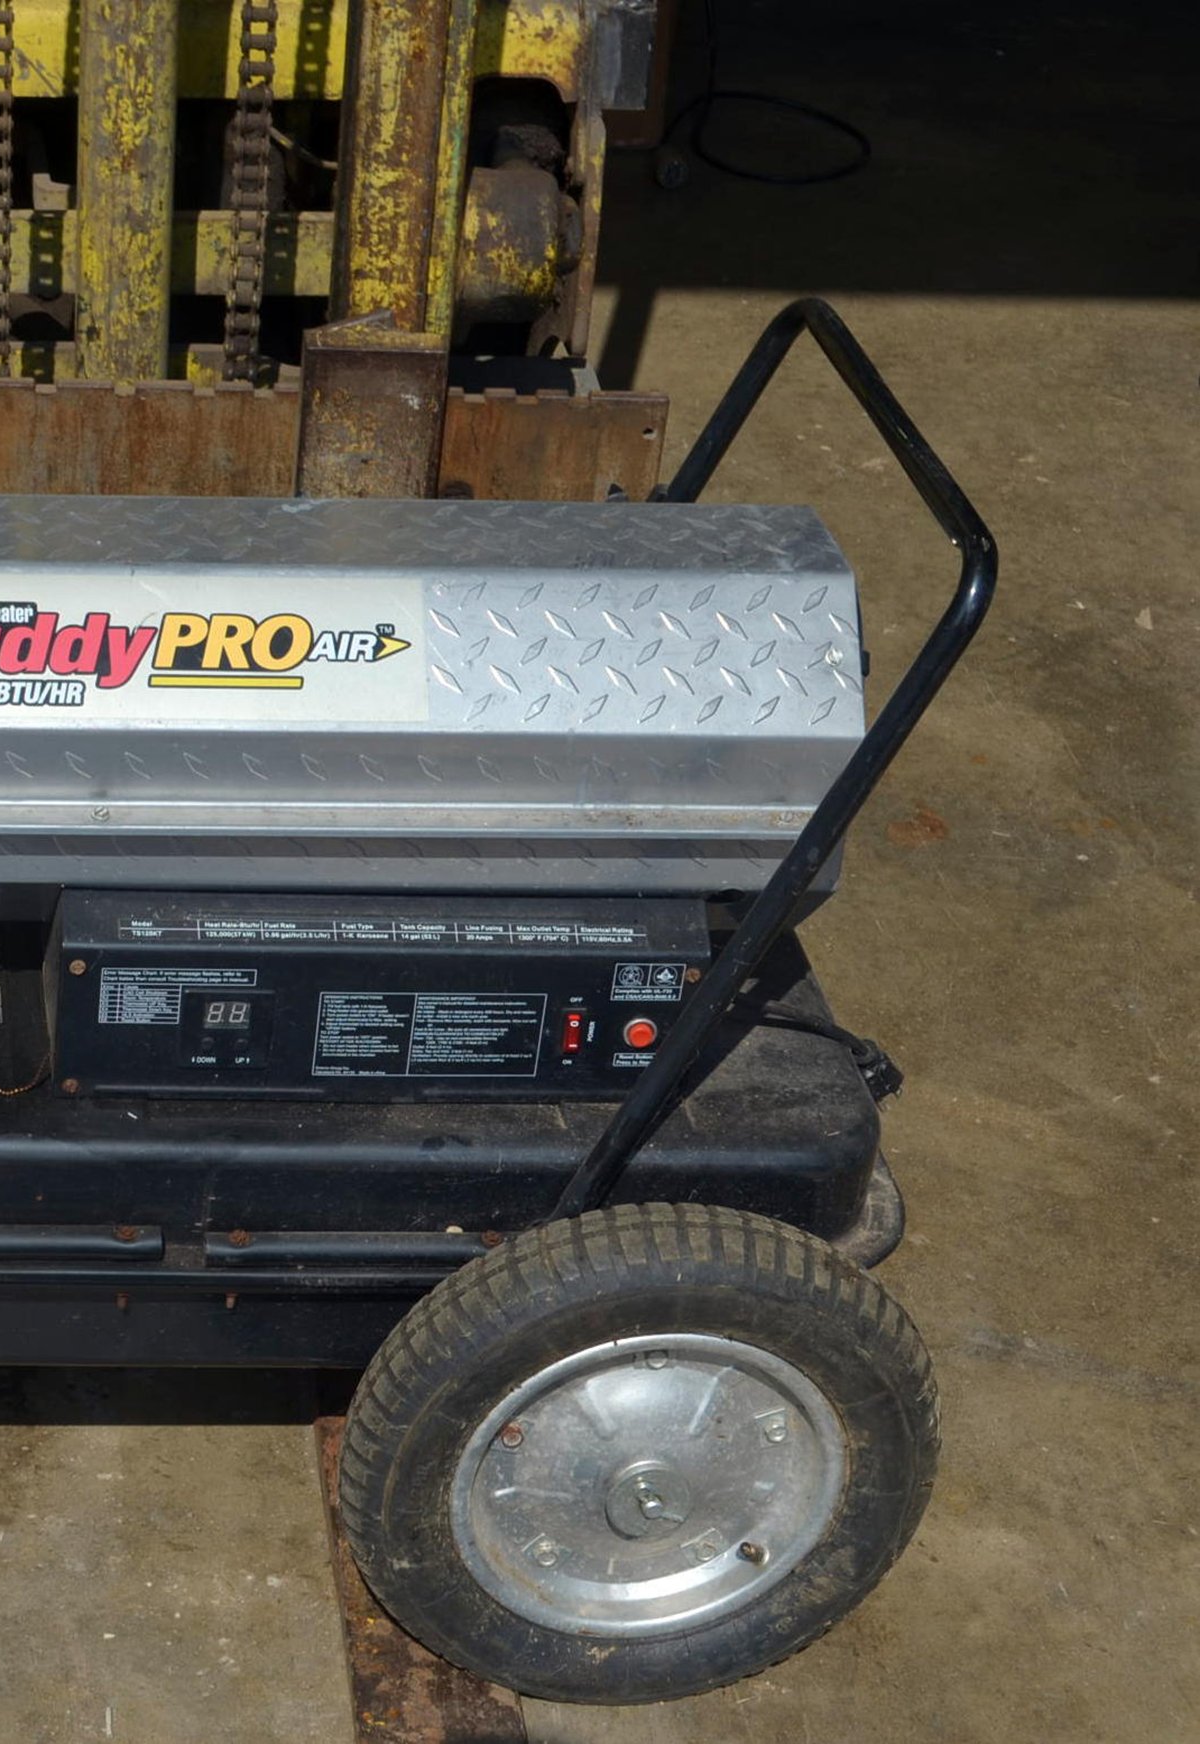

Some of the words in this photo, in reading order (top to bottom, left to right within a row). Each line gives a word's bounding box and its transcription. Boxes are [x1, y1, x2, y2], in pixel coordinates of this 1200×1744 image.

[152, 613, 314, 672] PRO
[307, 631, 378, 662] AIR
[587, 1020, 596, 1042] POWER
